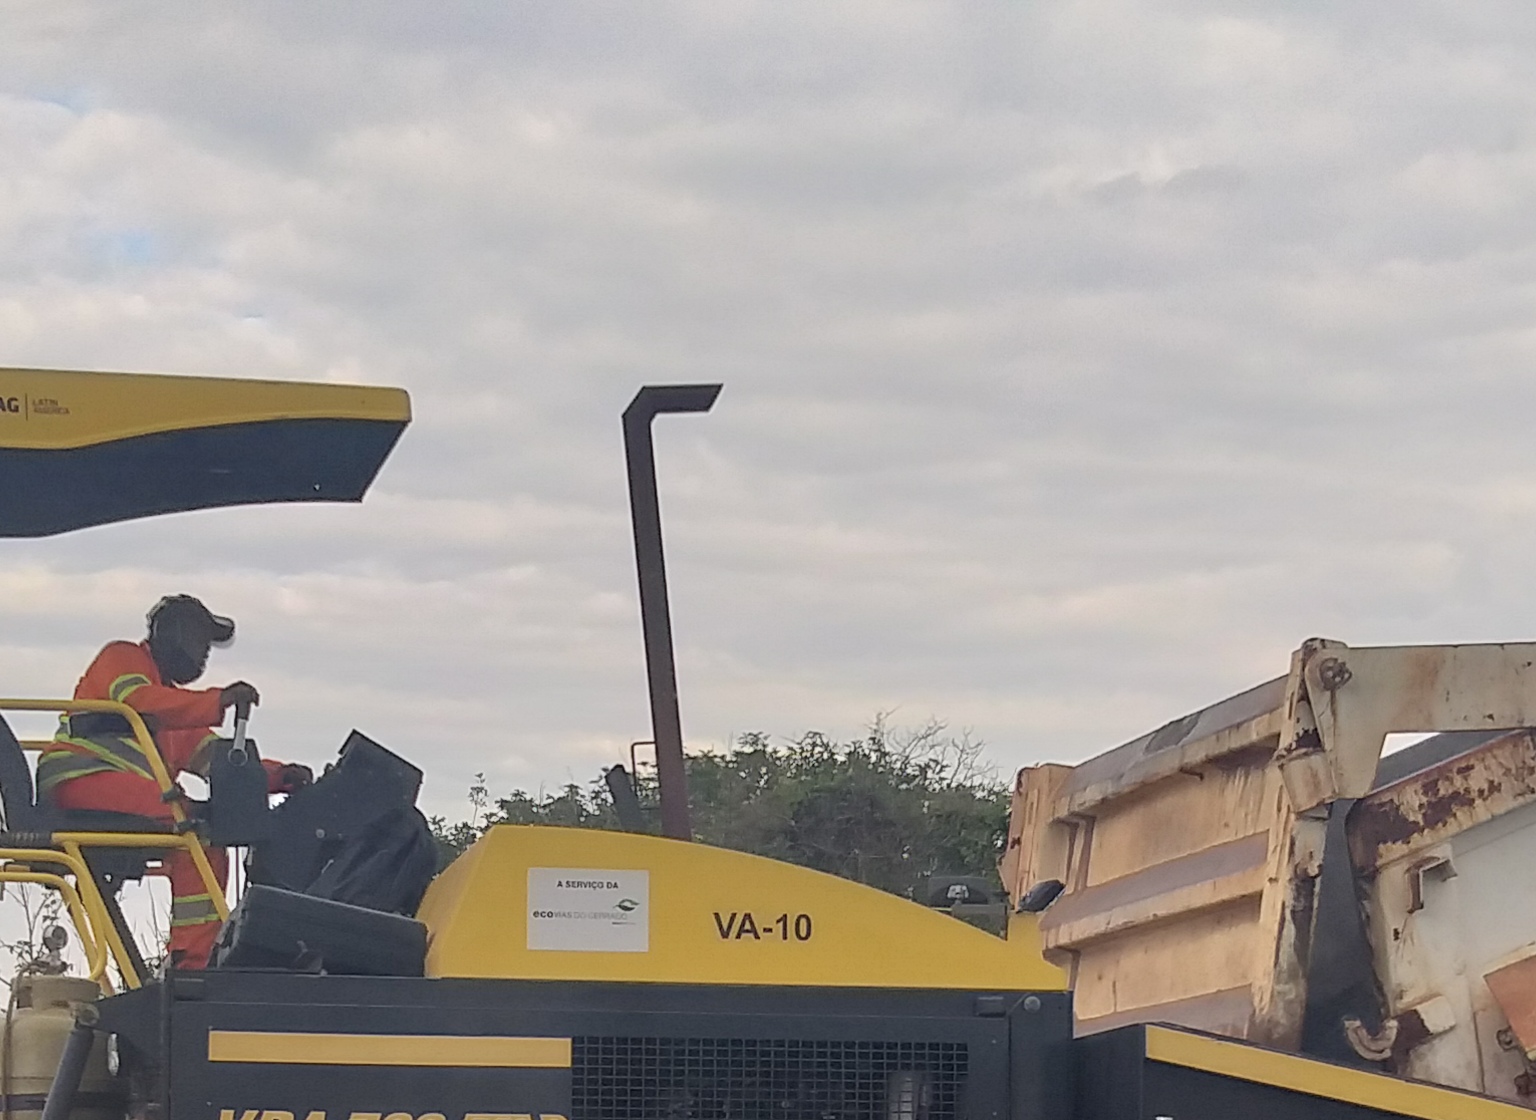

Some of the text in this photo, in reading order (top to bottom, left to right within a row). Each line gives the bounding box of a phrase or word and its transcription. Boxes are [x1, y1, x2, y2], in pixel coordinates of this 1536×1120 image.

[556, 880, 619, 890] A SERVIÇO DA
[712, 911, 812, 941] VA-10
